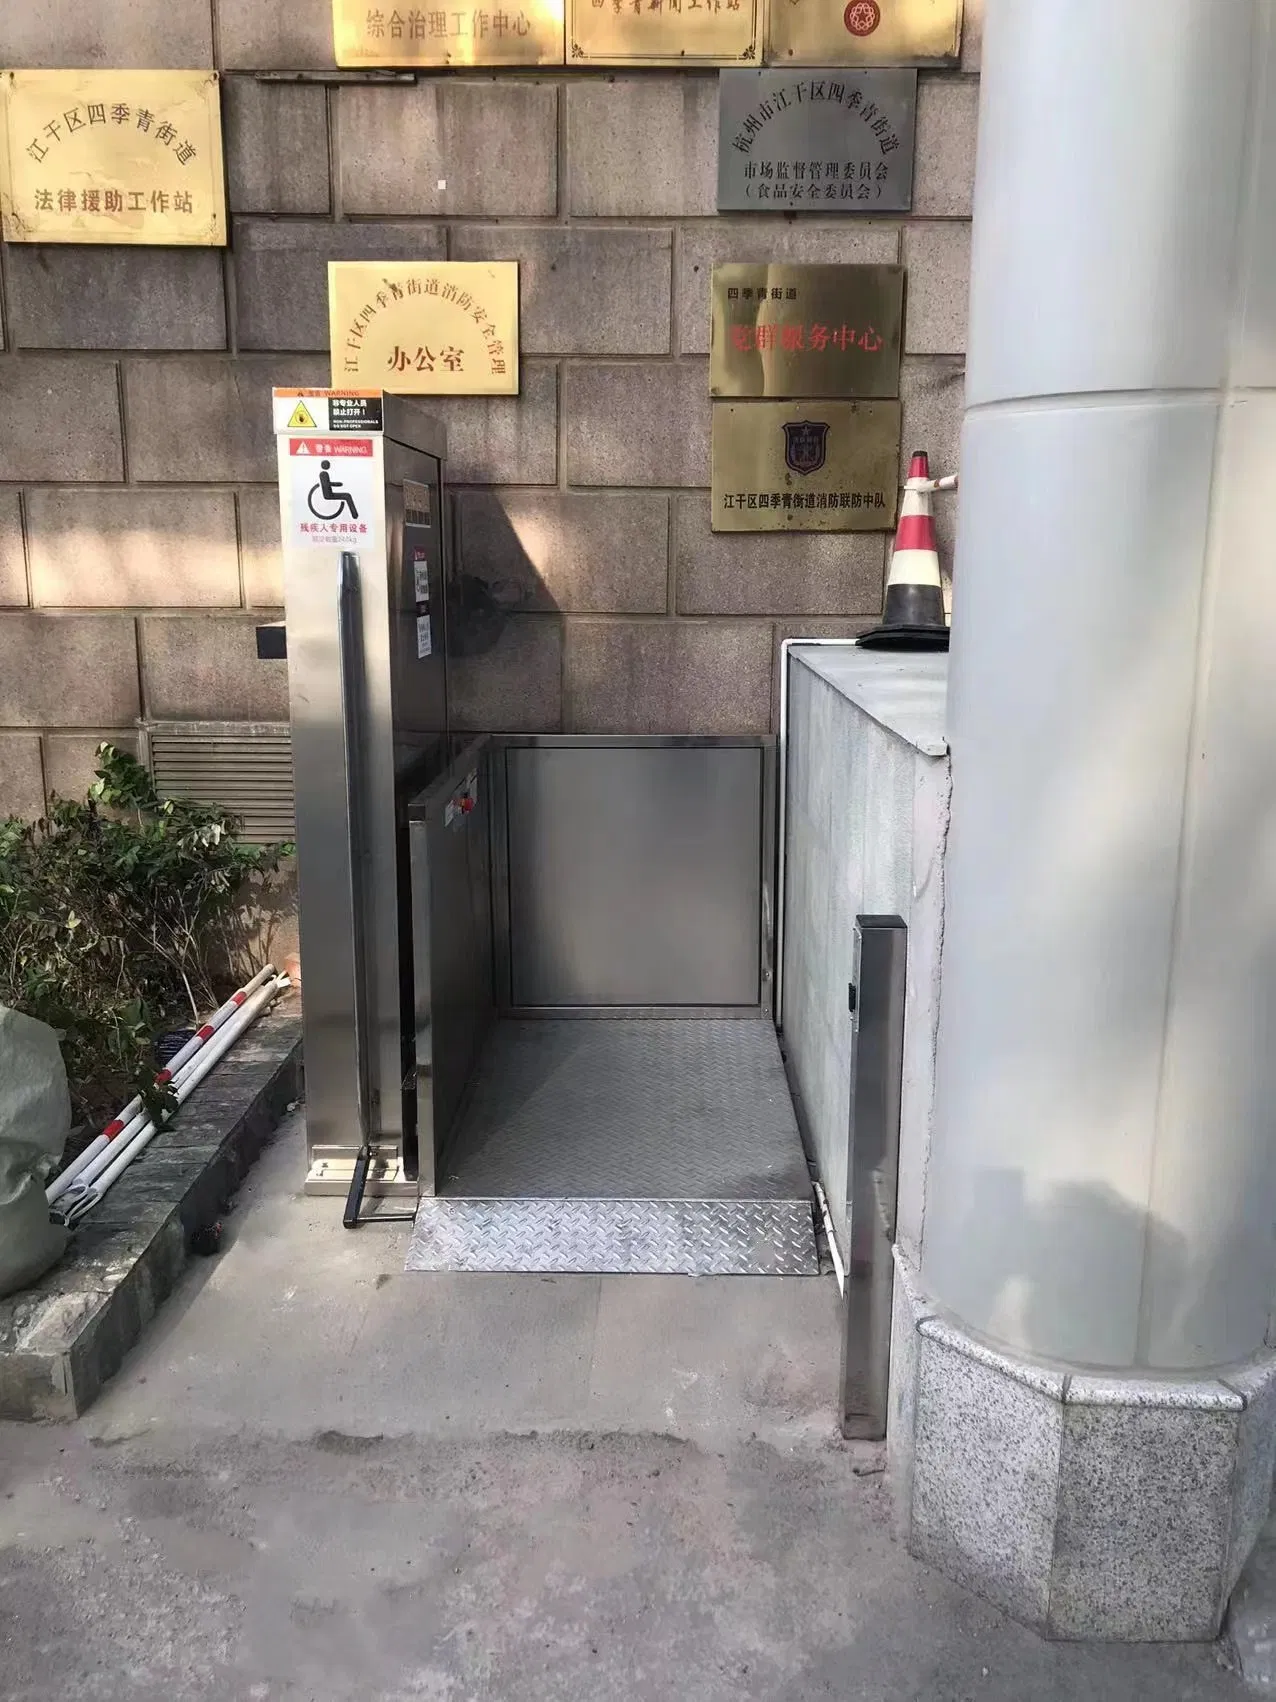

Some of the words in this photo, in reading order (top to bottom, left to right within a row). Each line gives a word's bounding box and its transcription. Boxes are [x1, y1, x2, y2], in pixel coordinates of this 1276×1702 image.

[366, 9, 531, 39] 综合治理工作中心
[732, 80, 901, 155] 杭州市江干区四季青街道
[26, 103, 197, 165] 江干区四季青街道
[743, 161, 889, 181] 市场监督管理委员会
[34, 188, 193, 213] 法律援助工作站
[727, 287, 797, 300] 四季青街道
[344, 278, 507, 375] 江干区四季青街道消防安全管理
[731, 323, 884, 352] 党群服务中心
[386, 345, 465, 373] 办公室
[723, 493, 886, 509] 江干区四季青街道消防联防中队
[300, 522, 368, 533] 残疾人专用设备
